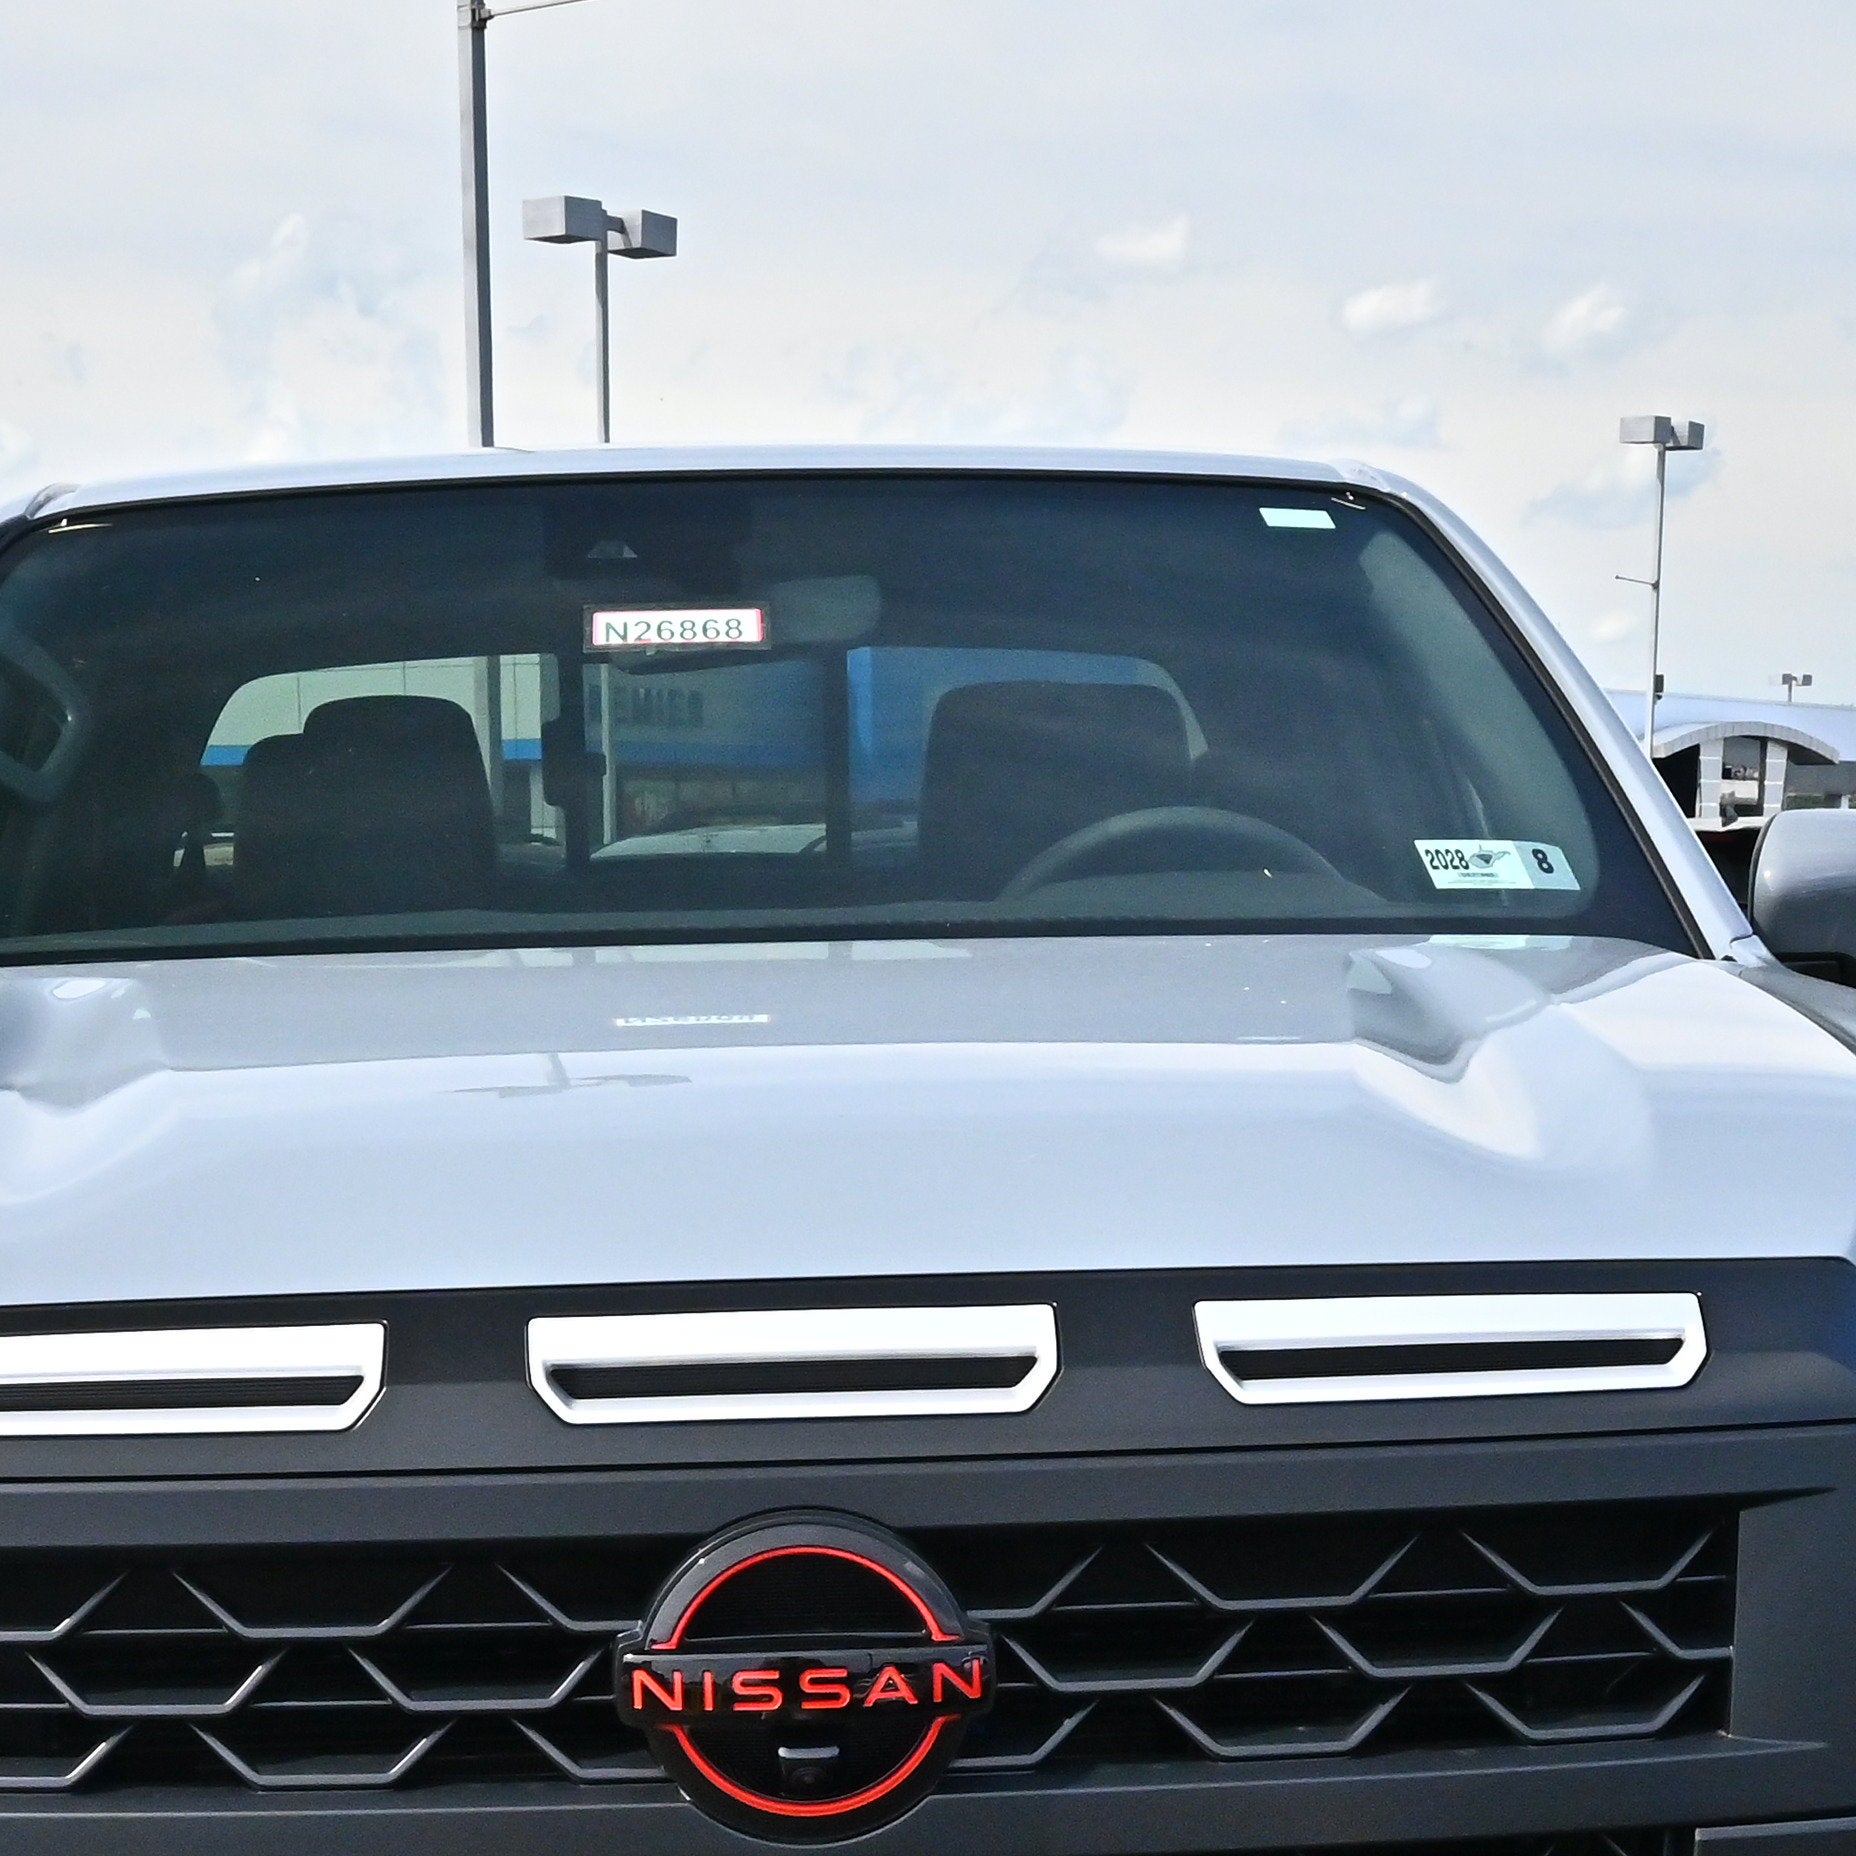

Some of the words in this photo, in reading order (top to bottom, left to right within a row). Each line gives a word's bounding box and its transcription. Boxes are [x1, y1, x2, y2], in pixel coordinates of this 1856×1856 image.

[604, 617, 744, 643] N26868
[1424, 848, 1470, 870] 2028
[1531, 848, 1555, 874] 8
[631, 1658, 984, 1712] NISSAN
